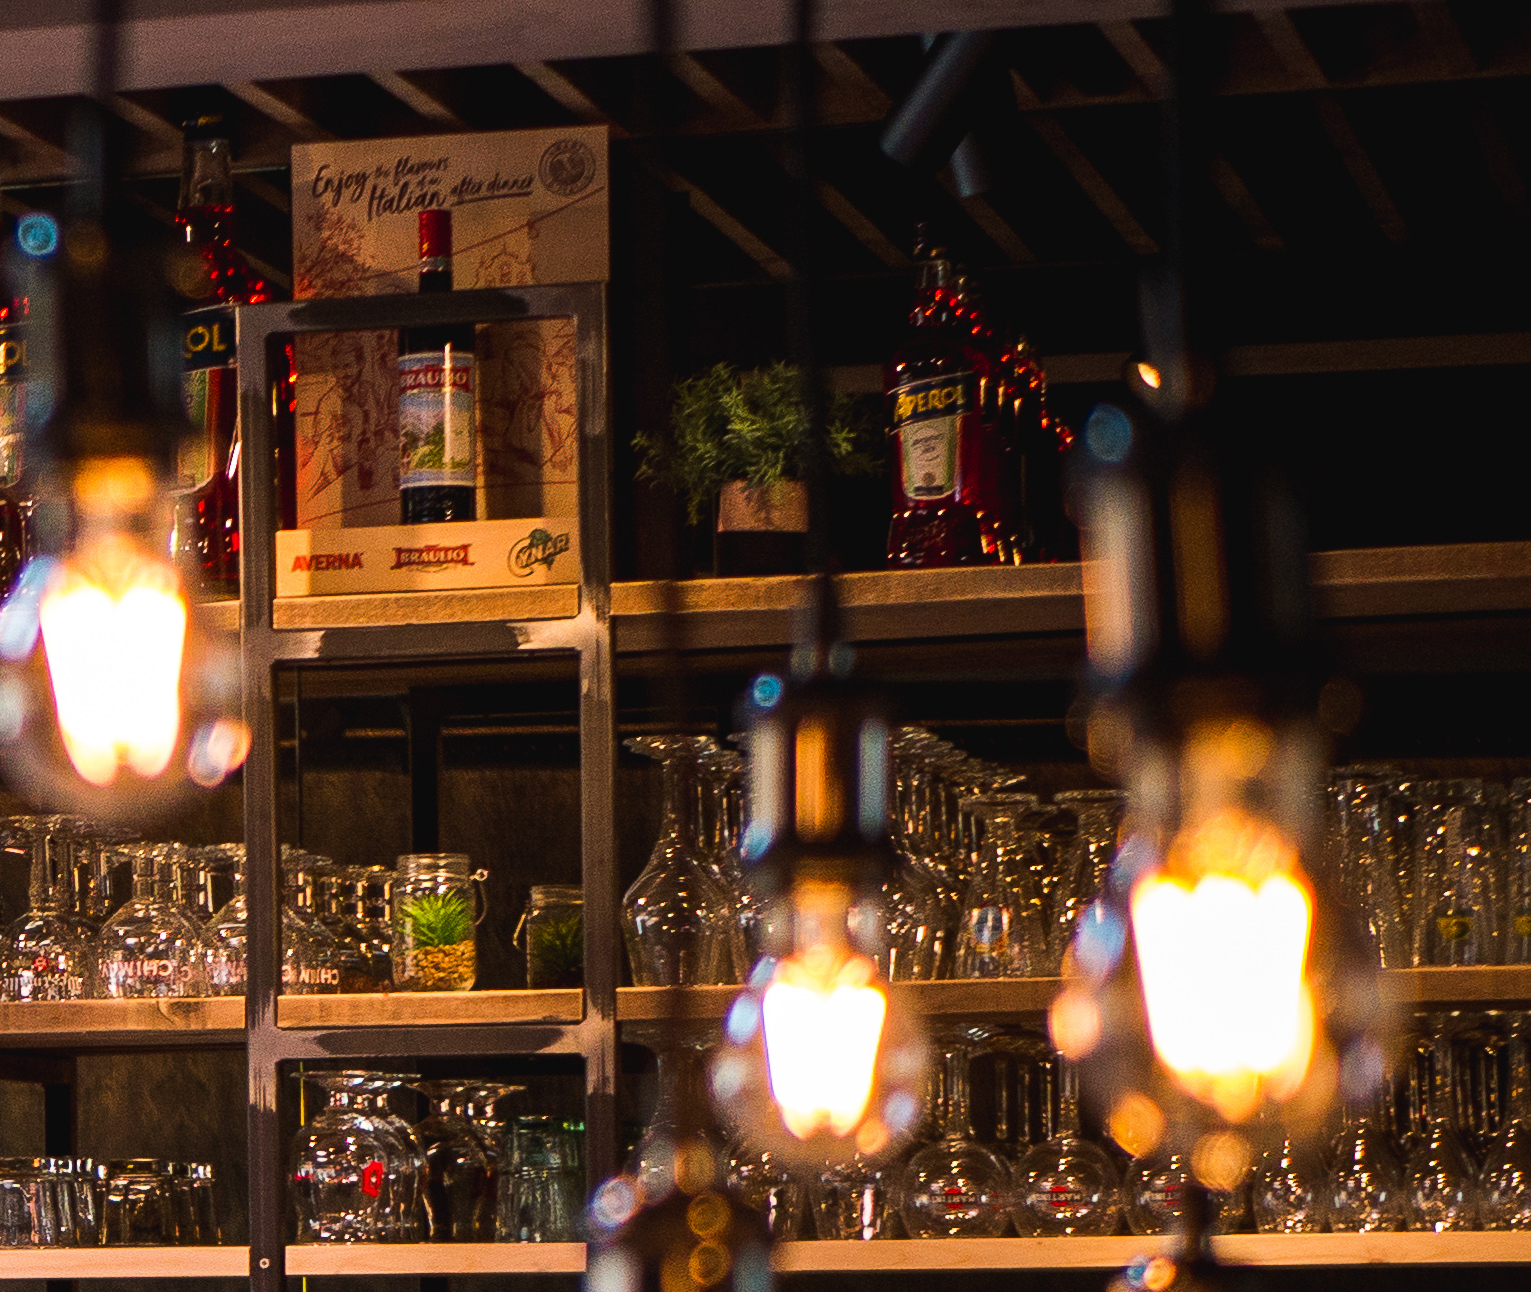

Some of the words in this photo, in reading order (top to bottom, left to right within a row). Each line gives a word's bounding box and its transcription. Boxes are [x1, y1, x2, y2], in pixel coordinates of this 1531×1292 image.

[312, 164, 369, 206] Enjoy
[368, 181, 447, 222] Italian
[290, 551, 363, 573] AVERNA
